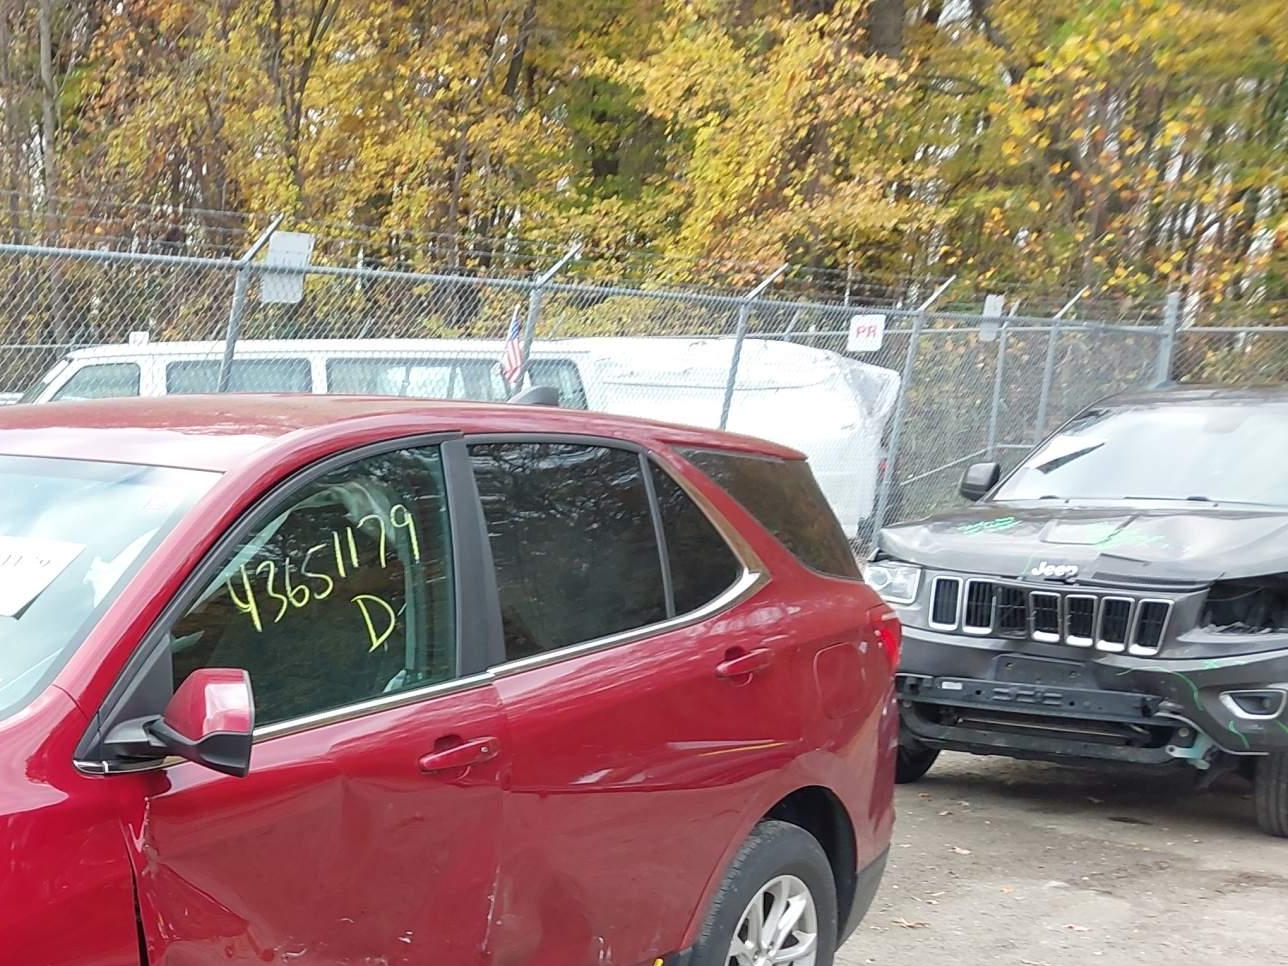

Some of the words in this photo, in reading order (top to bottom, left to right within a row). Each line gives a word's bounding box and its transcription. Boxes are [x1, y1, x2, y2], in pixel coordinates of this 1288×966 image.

[225, 503, 420, 633] 43651179
[1031, 561, 1079, 581] Jeep
[351, 594, 397, 653] D
